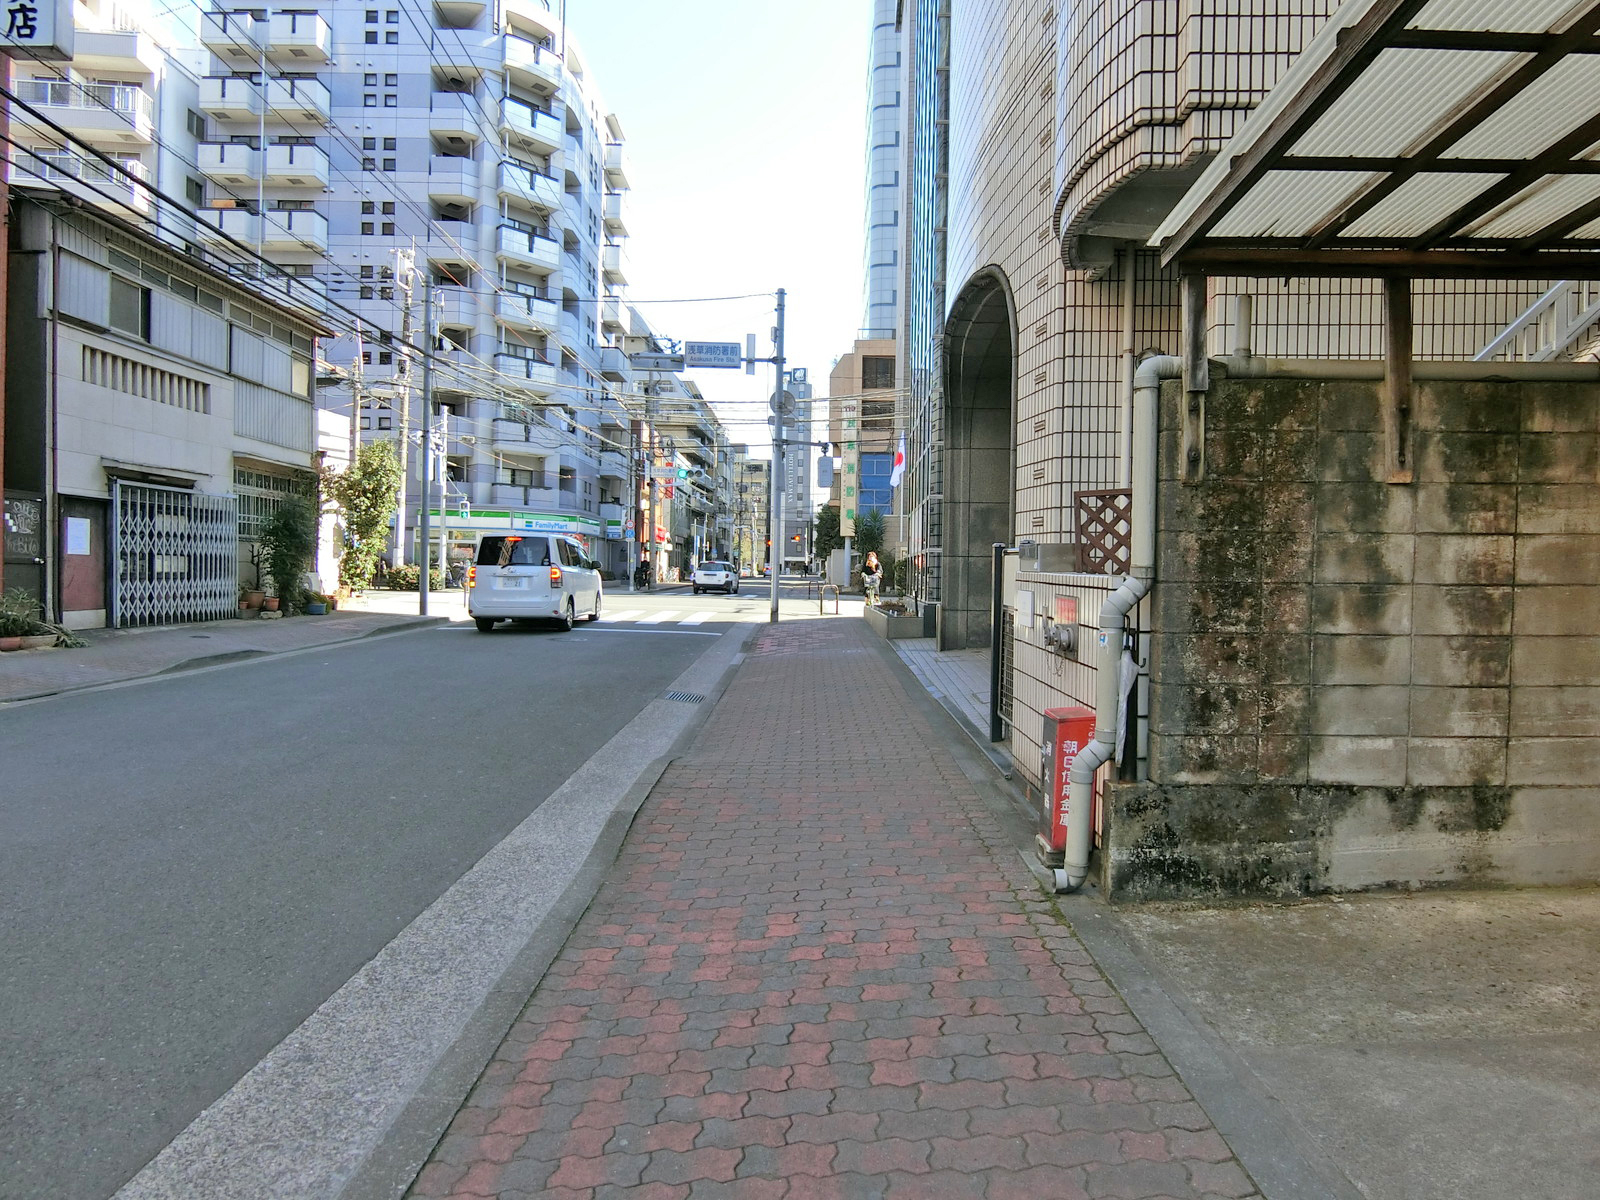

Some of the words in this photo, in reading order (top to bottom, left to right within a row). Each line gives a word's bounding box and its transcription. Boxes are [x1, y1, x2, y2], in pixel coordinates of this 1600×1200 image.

[7, 0, 38, 39] 店
[688, 345, 738, 356] 浅草消防署前
[535, 521, 568, 530] FamilyMart
